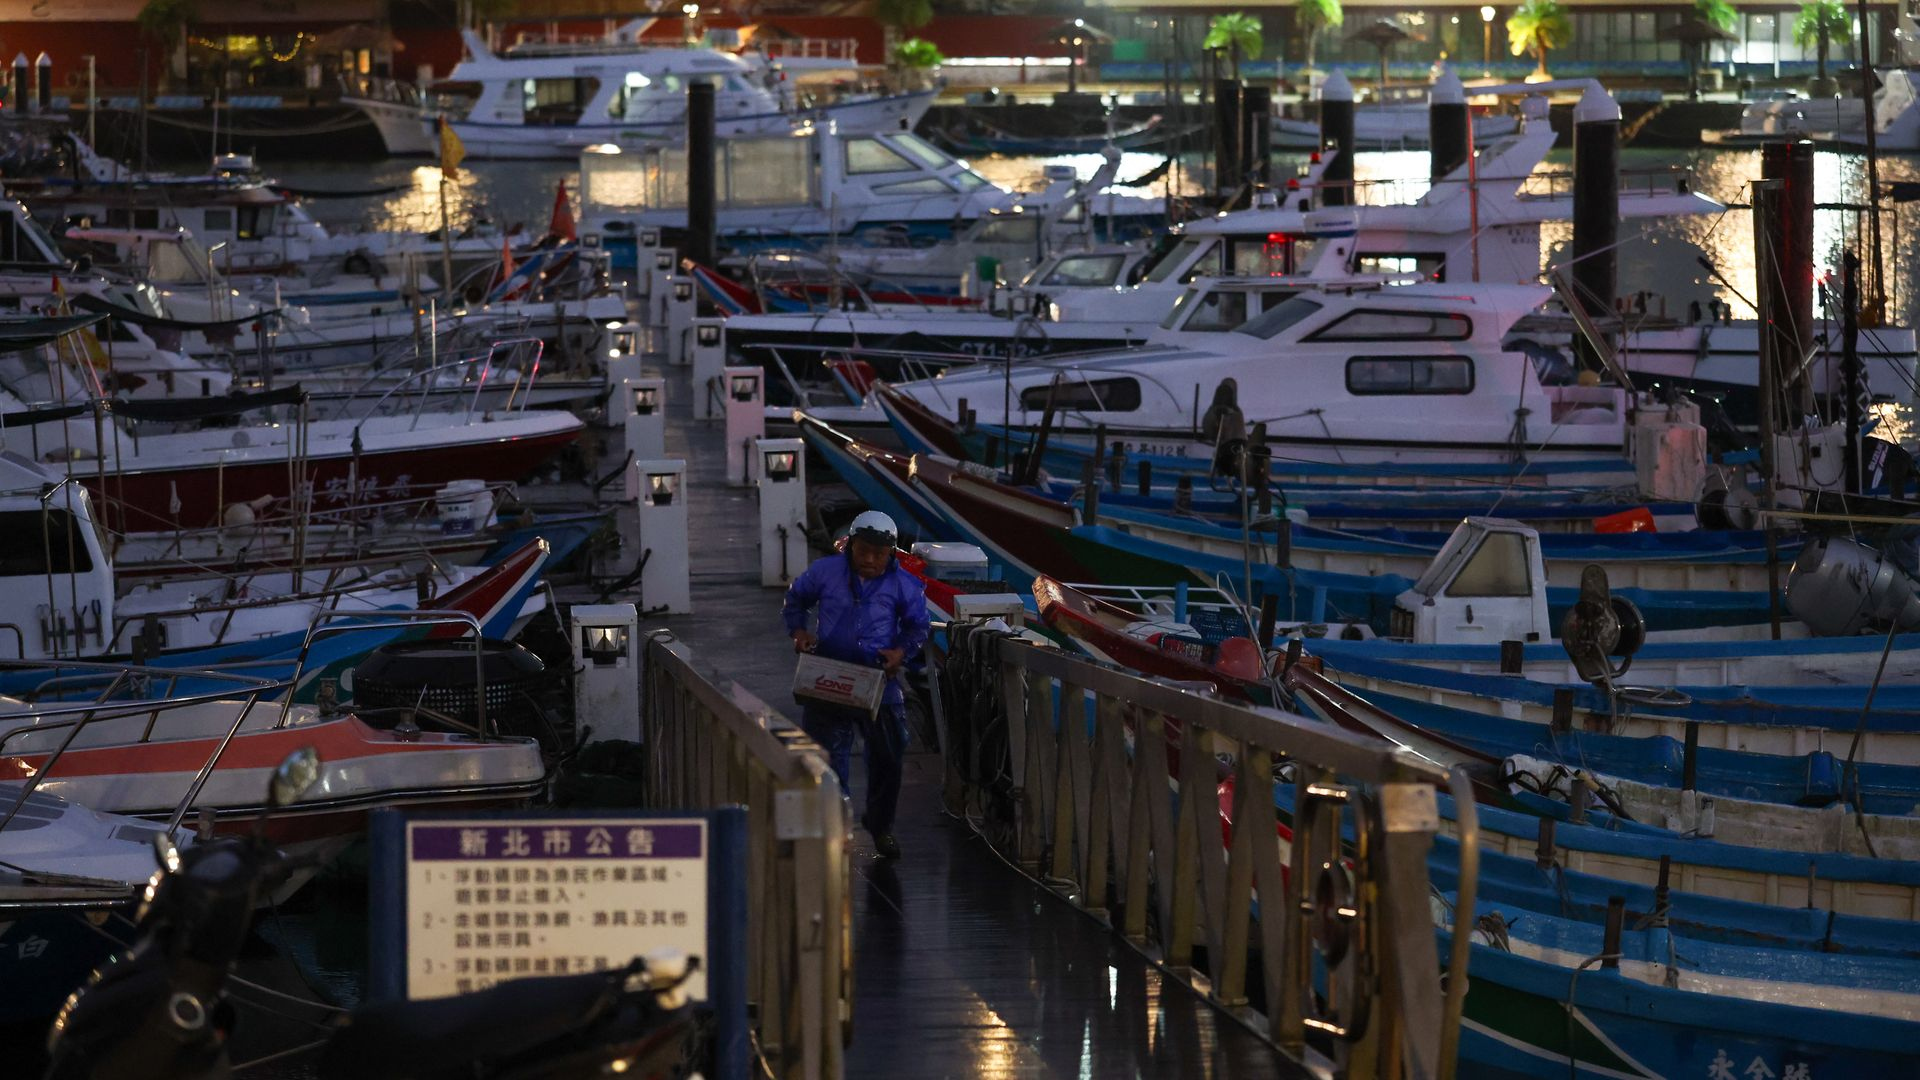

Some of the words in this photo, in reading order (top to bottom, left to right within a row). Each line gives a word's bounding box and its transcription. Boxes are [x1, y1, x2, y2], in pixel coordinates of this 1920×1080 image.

[815, 675, 854, 693] LONG
[458, 827, 656, 857] 新北市公告
